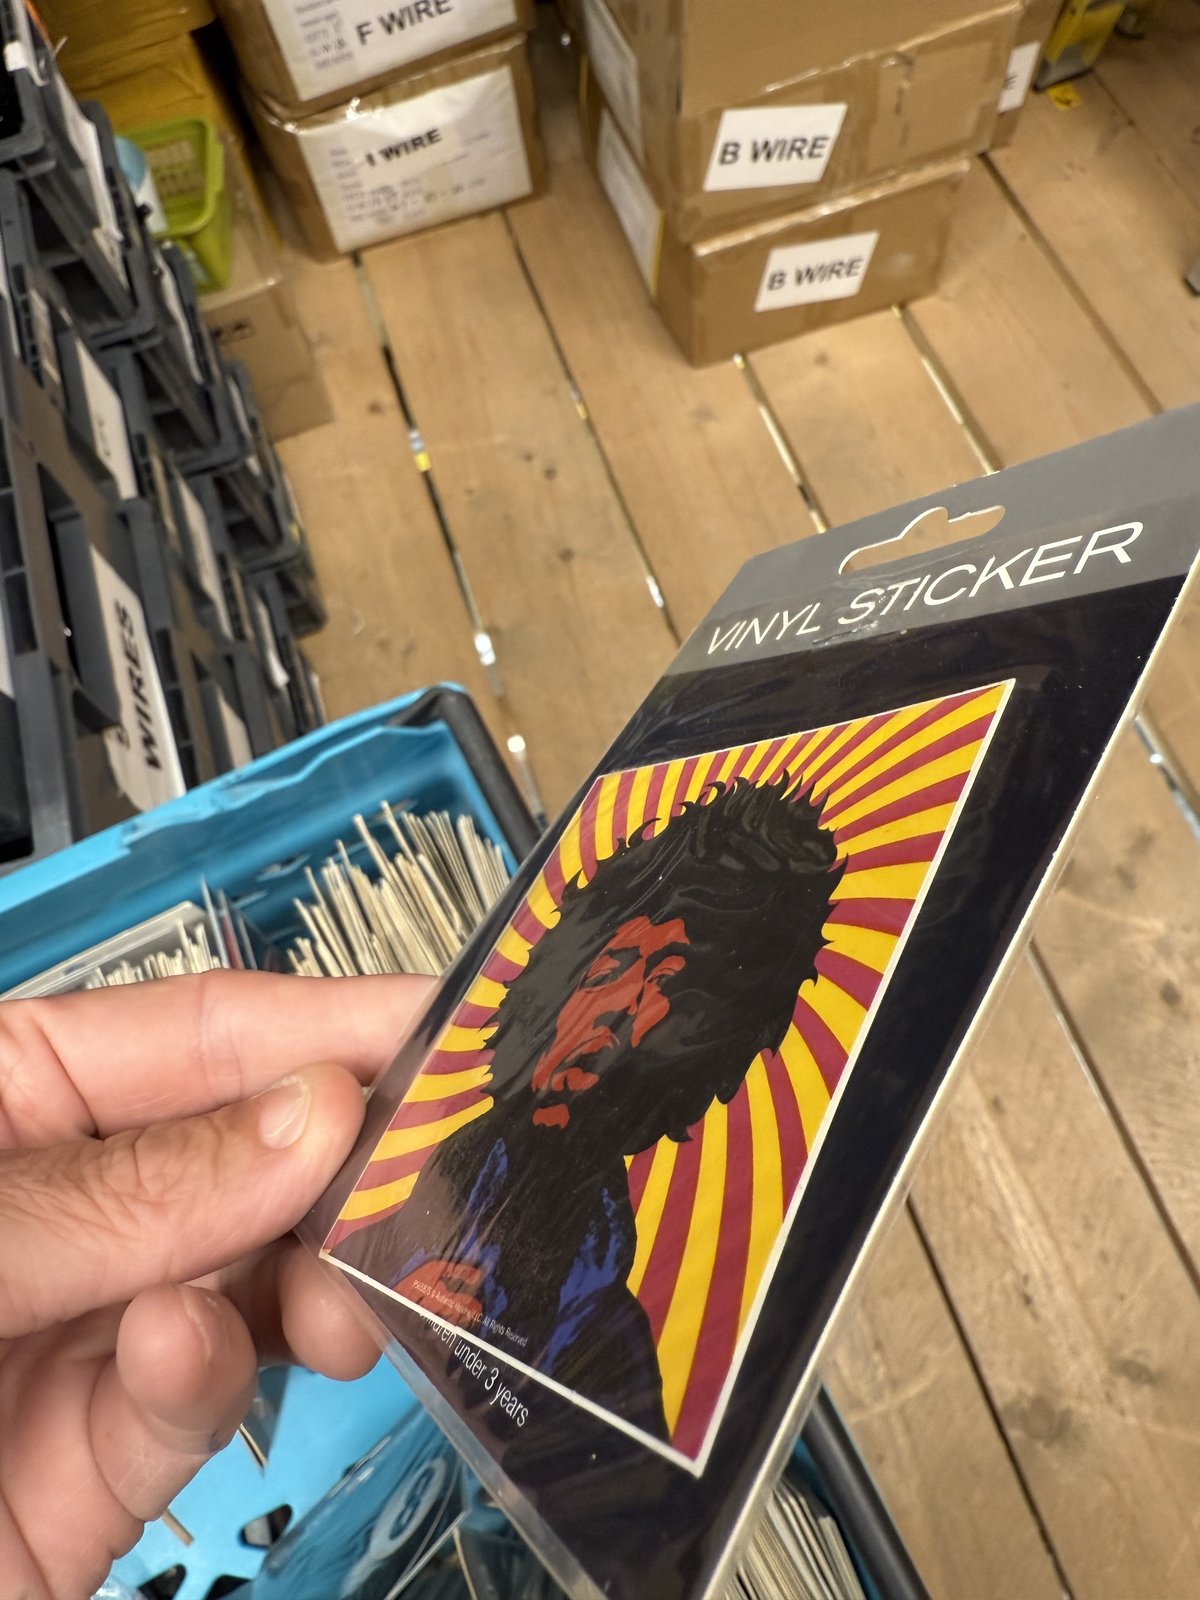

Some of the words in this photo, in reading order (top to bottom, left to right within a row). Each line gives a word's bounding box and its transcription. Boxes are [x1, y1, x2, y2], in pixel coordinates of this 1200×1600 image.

[356, 22, 373, 46] F
[380, 0, 453, 36] WIRE
[378, 129, 442, 163] WIRE
[719, 140, 740, 166] B
[751, 135, 831, 163] WIRE
[766, 270, 786, 291] B
[797, 259, 864, 285] WIRE
[707, 603, 821, 655] VINYL
[837, 521, 1145, 626] STICKER
[115, 598, 162, 770] WIRES
[454, 1339, 488, 1380] under
[484, 1368, 500, 1391] 3
[490, 1382, 529, 1428] years
